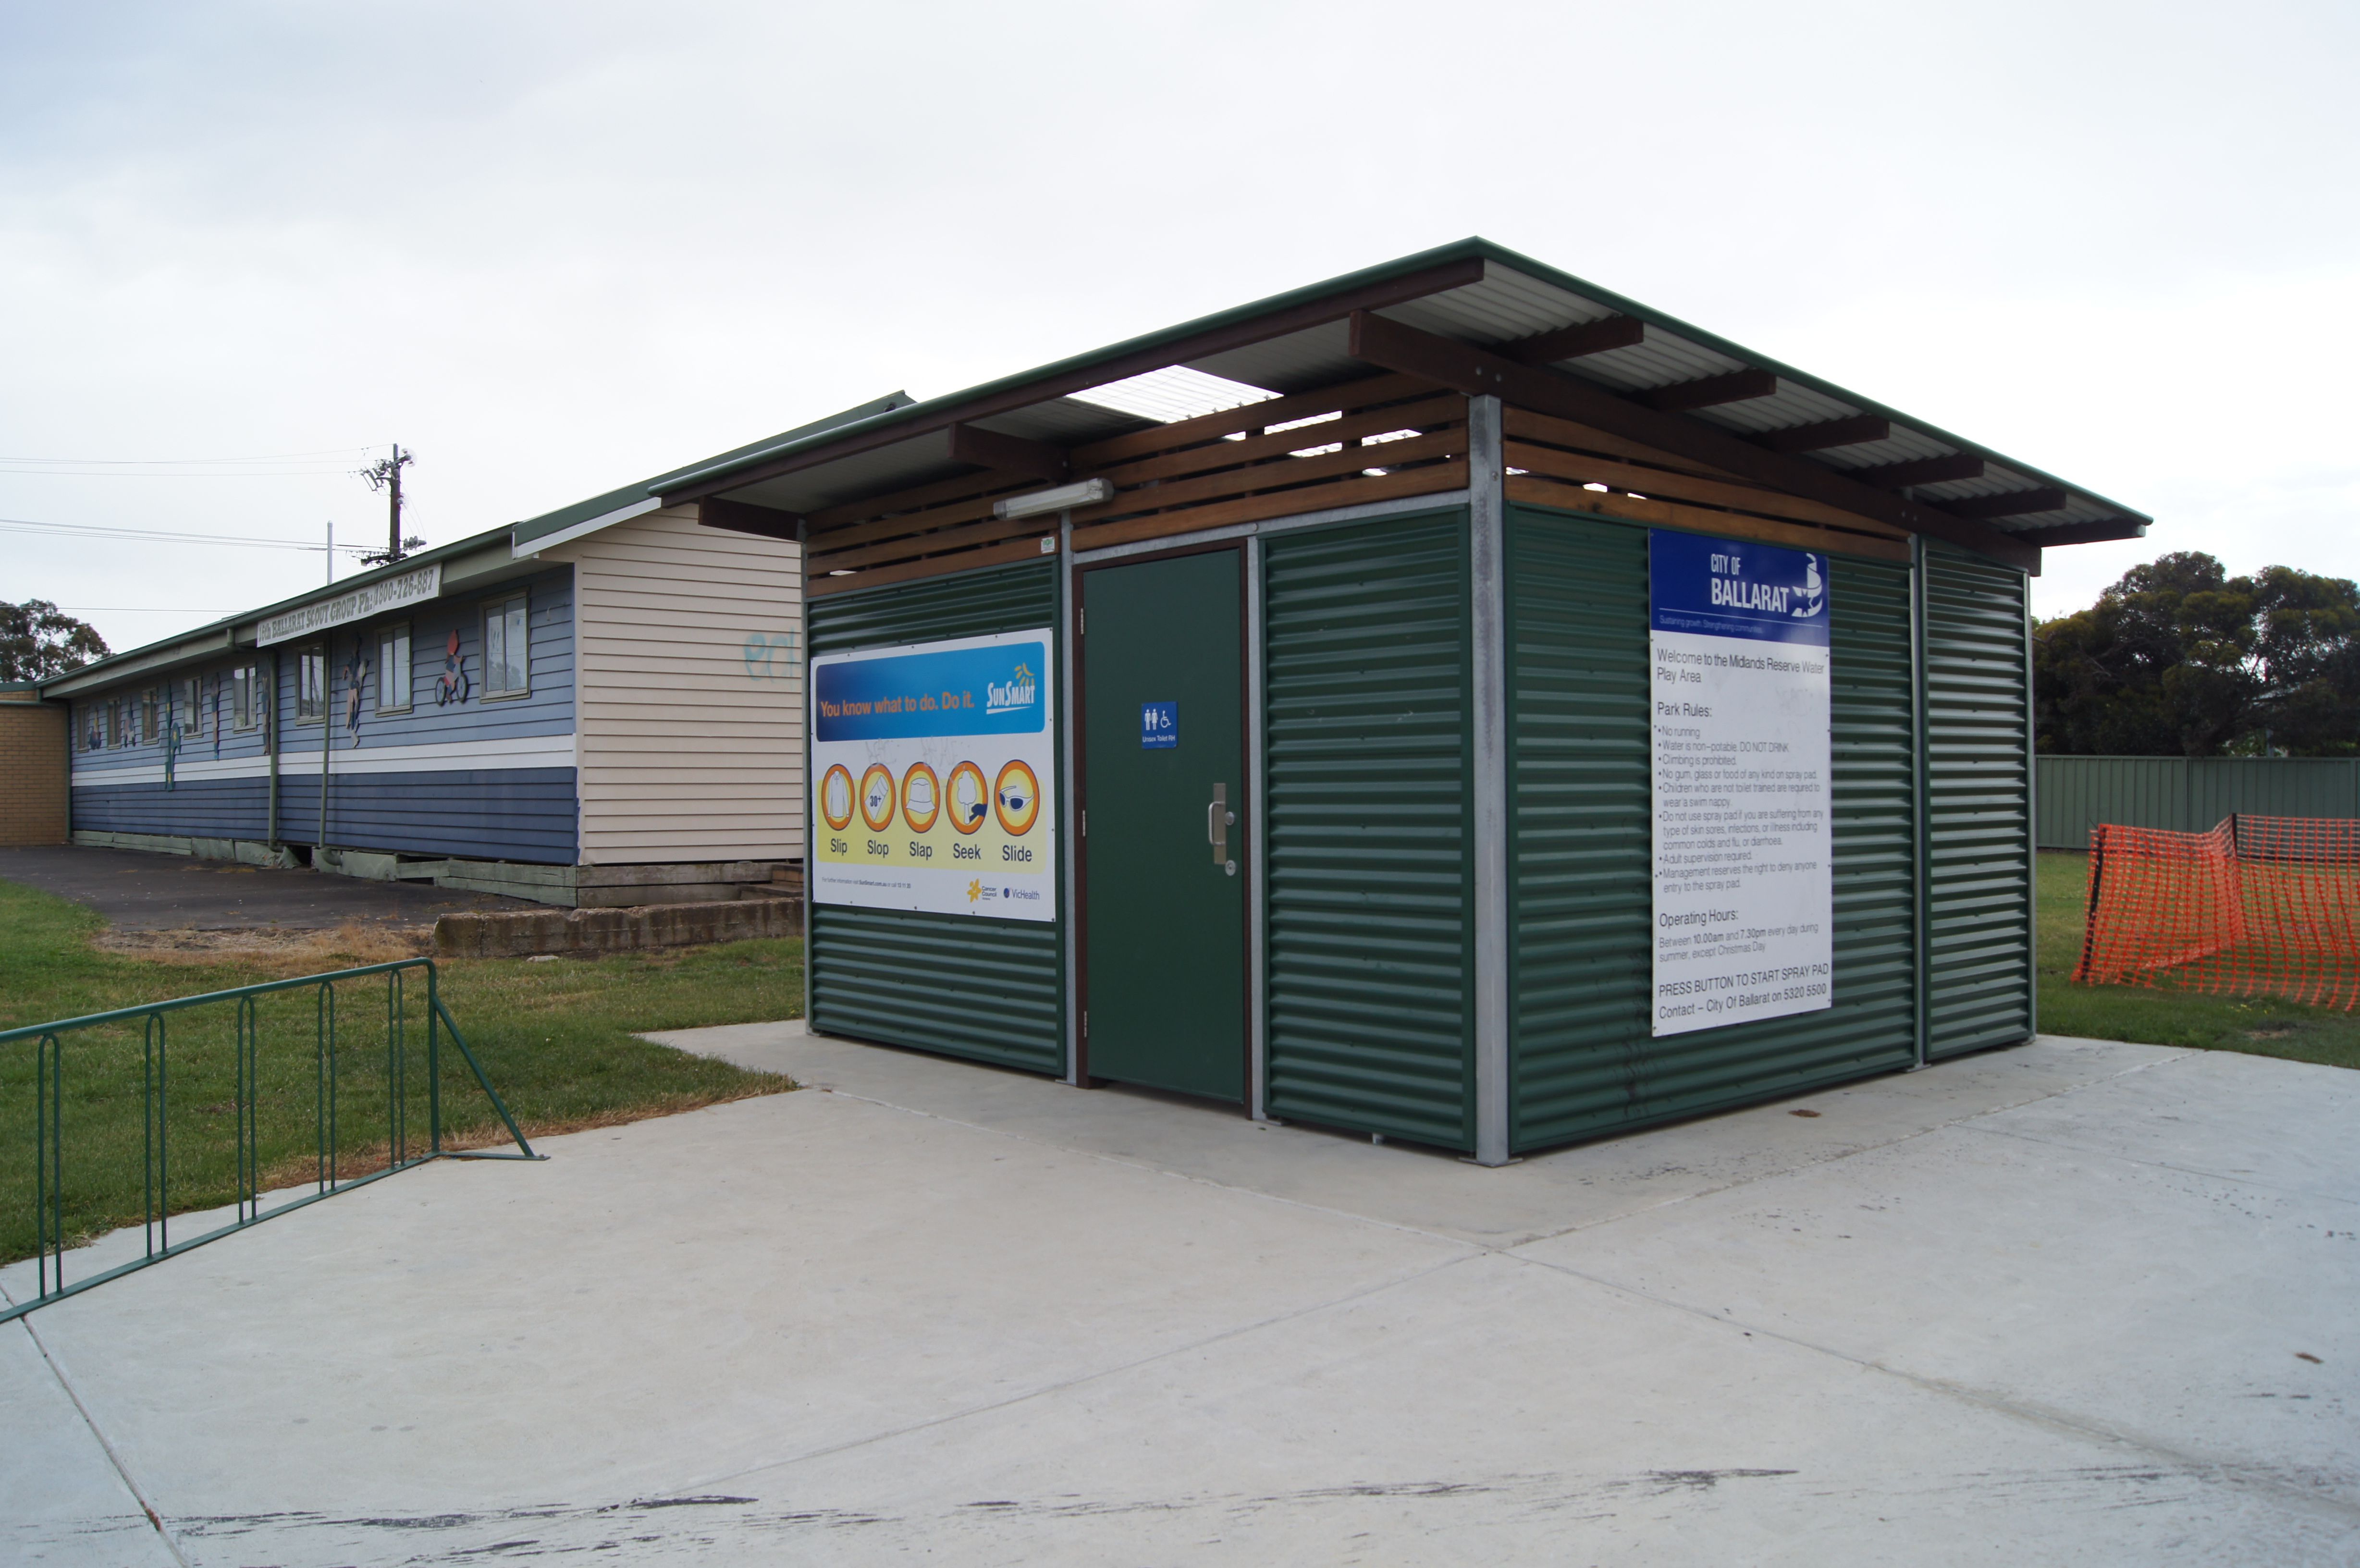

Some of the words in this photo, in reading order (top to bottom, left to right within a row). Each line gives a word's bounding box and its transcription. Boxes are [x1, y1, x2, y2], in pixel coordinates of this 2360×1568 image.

[1711, 553, 1729, 574] CITY
[1731, 557, 1740, 575] OF
[1711, 577, 1789, 612] BALLARAT
[272, 612, 306, 638] BALLARAT
[307, 604, 330, 628] SCOUT
[331, 596, 356, 622] GROUP
[1657, 648, 1702, 664] Welcome
[1704, 653, 1712, 665] to
[1714, 654, 1727, 666] the
[1730, 654, 1765, 670] Midlands
[1767, 658, 1800, 672] Reserve
[1802, 661, 1824, 674] Water
[1657, 667, 1676, 684] Play
[1680, 669, 1701, 683] Area
[821, 701, 839, 717] You
[843, 700, 871, 716] know
[874, 697, 902, 713] what
[905, 696, 916, 711] to
[920, 694, 938, 710] do.
[942, 692, 959, 709] Do
[963, 691, 974, 708] it.
[1658, 702, 1680, 715] Park
[1684, 703, 1712, 717] Rules:
[1662, 726, 1672, 736] No
[1674, 729, 1700, 739] running
[1662, 740, 1685, 751] Water
[1740, 742, 1751, 752] DO
[1753, 742, 1767, 752] NOT
[1769, 743, 1789, 752] DRINK
[1662, 754, 1694, 767] Climbing
[1695, 756, 1700, 765] is
[1662, 769, 1672, 779] No
[1675, 771, 1692, 781] gum,
[1694, 770, 1712, 781] glass
[1723, 769, 1738, 779] food
[1740, 769, 1746, 779] of
[1748, 772, 1759, 781] any
[1761, 770, 1775, 779] kind
[1785, 771, 1802, 781] spray
[1663, 783, 1692, 793] Children
[1694, 784, 1709, 793] who
[1723, 784, 1734, 793] not
[1736, 784, 1752, 793] toilet
[1753, 784, 1775, 792] trained
[1788, 784, 1812, 794] required
[1663, 799, 1681, 807] wear
[1683, 799, 1688, 807] a
[1689, 797, 1707, 807] swim
[1663, 811, 1673, 821] Do
[1675, 812, 1687, 821] not
[1689, 812, 1701, 821] use
[1703, 812, 1722, 822] spray
[1724, 811, 1737, 821] pad
[1738, 810, 1743, 820] if
[1744, 811, 1756, 821] you
[1770, 809, 1796, 820] suffering
[1797, 808, 1812, 818] from
[1813, 810, 1823, 819] any
[1663, 826, 1680, 838] type
[1682, 826, 1689, 835] of
[1691, 825, 1704, 835] skin
[1706, 825, 1727, 834] sores,
[1792, 821, 1817, 833] including
[831, 838, 848, 855] Slip
[867, 840, 889, 858] Slop
[910, 841, 933, 860] Slap
[953, 843, 981, 859] Seek
[1002, 845, 1032, 862] Slide
[1663, 841, 1695, 850] common
[1697, 839, 1715, 848] colds
[1717, 839, 1730, 847] and
[1743, 838, 1749, 846] or
[1663, 854, 1682, 864] Adult
[1684, 853, 1722, 864] supervision
[1663, 868, 1710, 880] Management
[1711, 866, 1741, 875] reserves
[1742, 864, 1753, 873] the
[1754, 863, 1768, 875] right
[1770, 863, 1776, 872] to
[1778, 861, 1792, 872] deny
[1795, 861, 1817, 872] anyone
[1012, 889, 1040, 900] VicHealth
[1664, 883, 1682, 894] entry
[1684, 883, 1691, 891] to
[1693, 882, 1704, 890] the
[1706, 882, 1724, 891] spray
[1659, 911, 1706, 929] Operating
[1709, 909, 1738, 922] Hours:
[1659, 937, 1692, 948] Between
[1694, 933, 1724, 944] 10.00am
[1726, 931, 1739, 941] and
[1740, 928, 1766, 939] 7.30pm
[1768, 927, 1785, 937] every
[1787, 924, 1798, 935] day
[1801, 923, 1819, 933] during
[1659, 953, 1691, 962] summer,
[1692, 948, 1716, 958] except
[1718, 943, 1751, 955] Christmas
[1753, 941, 1766, 952] Day
[1659, 981, 1692, 997] PRESS
[1695, 976, 1733, 992] BUTTON
[1736, 973, 1748, 986] TO
[1751, 969, 1779, 985] START
[1782, 966, 1810, 980] SPRAY
[1812, 963, 1829, 975] PAD
[1659, 1003, 1695, 1018] Contact
[1707, 998, 1723, 1013] City
[1726, 996, 1737, 1009] Of
[1739, 992, 1770, 1006] Ballarat
[1772, 992, 1782, 1002] on
[1784, 986, 1805, 1000] 5320
[1807, 983, 1827, 996] 5500
